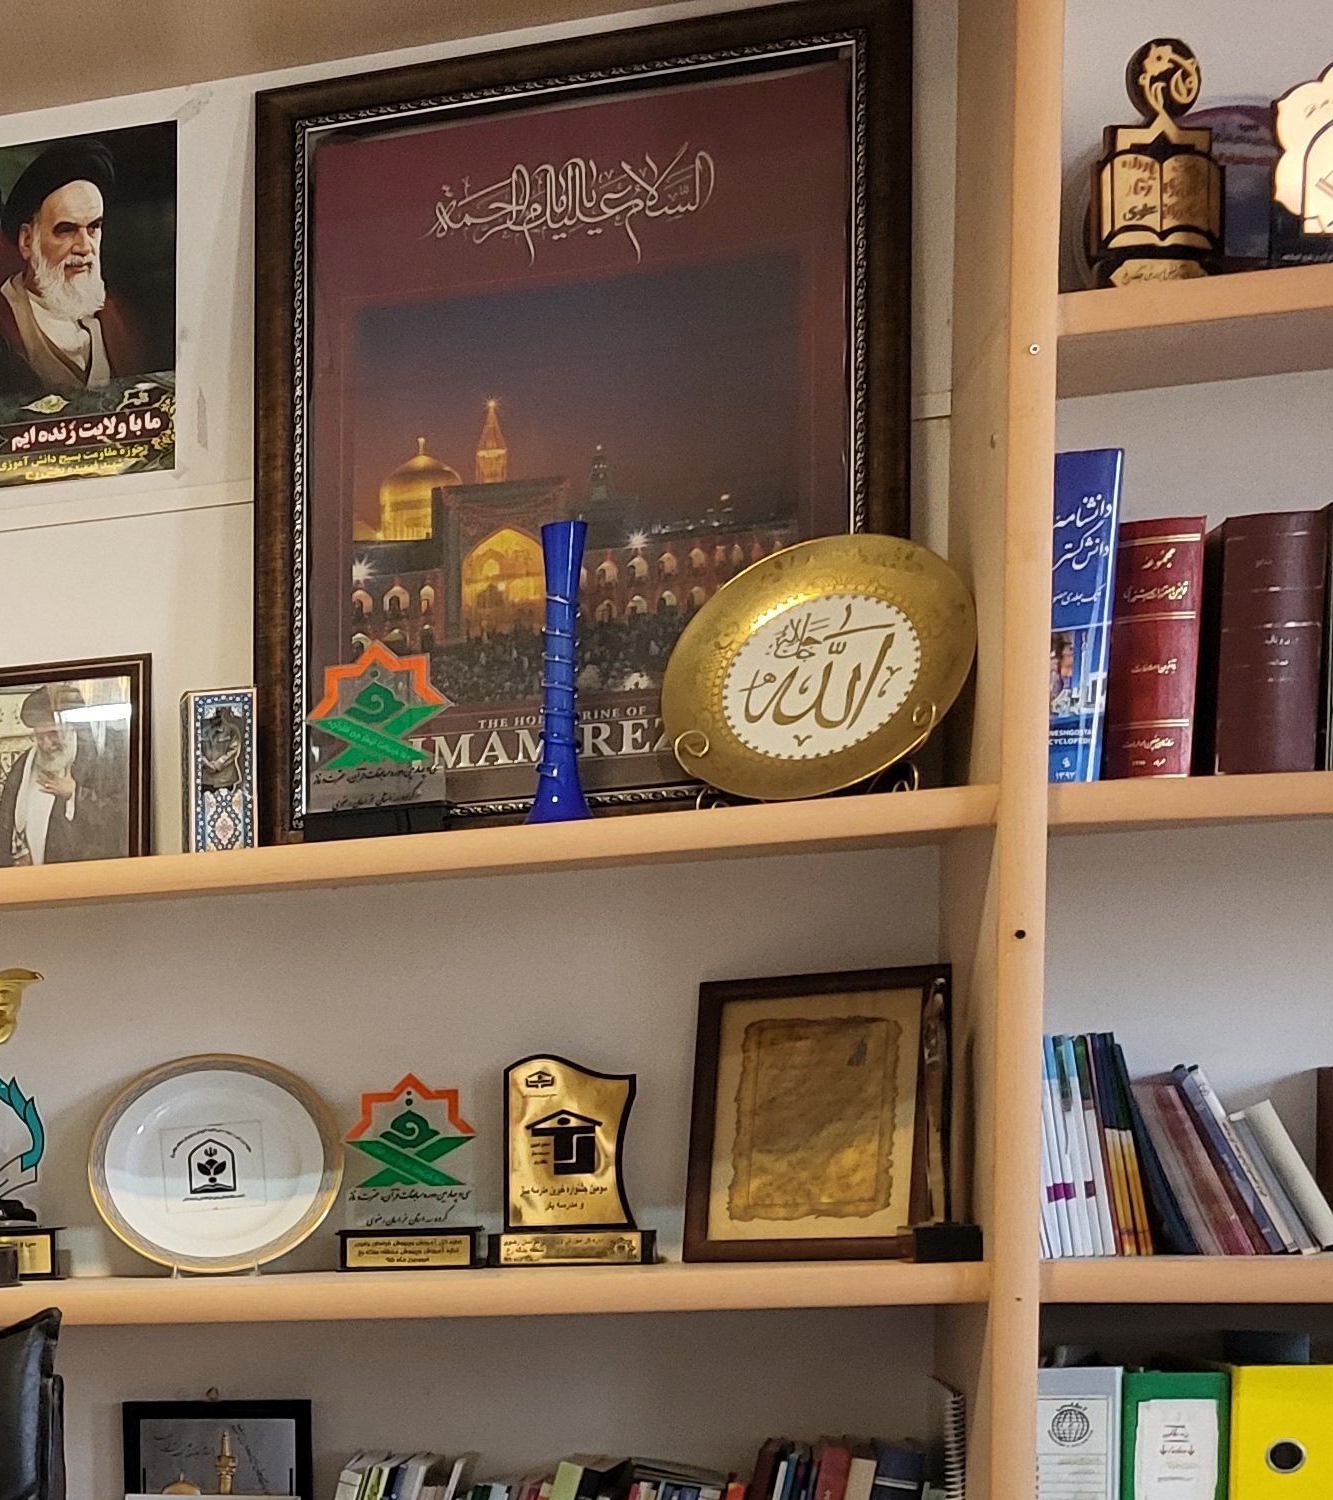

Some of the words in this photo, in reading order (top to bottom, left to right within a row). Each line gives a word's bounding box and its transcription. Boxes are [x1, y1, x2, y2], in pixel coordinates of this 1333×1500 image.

[78, 415, 126, 439] ولایت
[128, 413, 142, 436] با
[143, 411, 161, 430] ما
[11, 425, 36, 451] ایم
[38, 421, 77, 445] زنده
[31, 452, 57, 467] دانش
[1071, 536, 1110, 571] دانش
[477, 717, 509, 731] THE
[626, 705, 647, 718] OF
[578, 717, 674, 759] REZ
